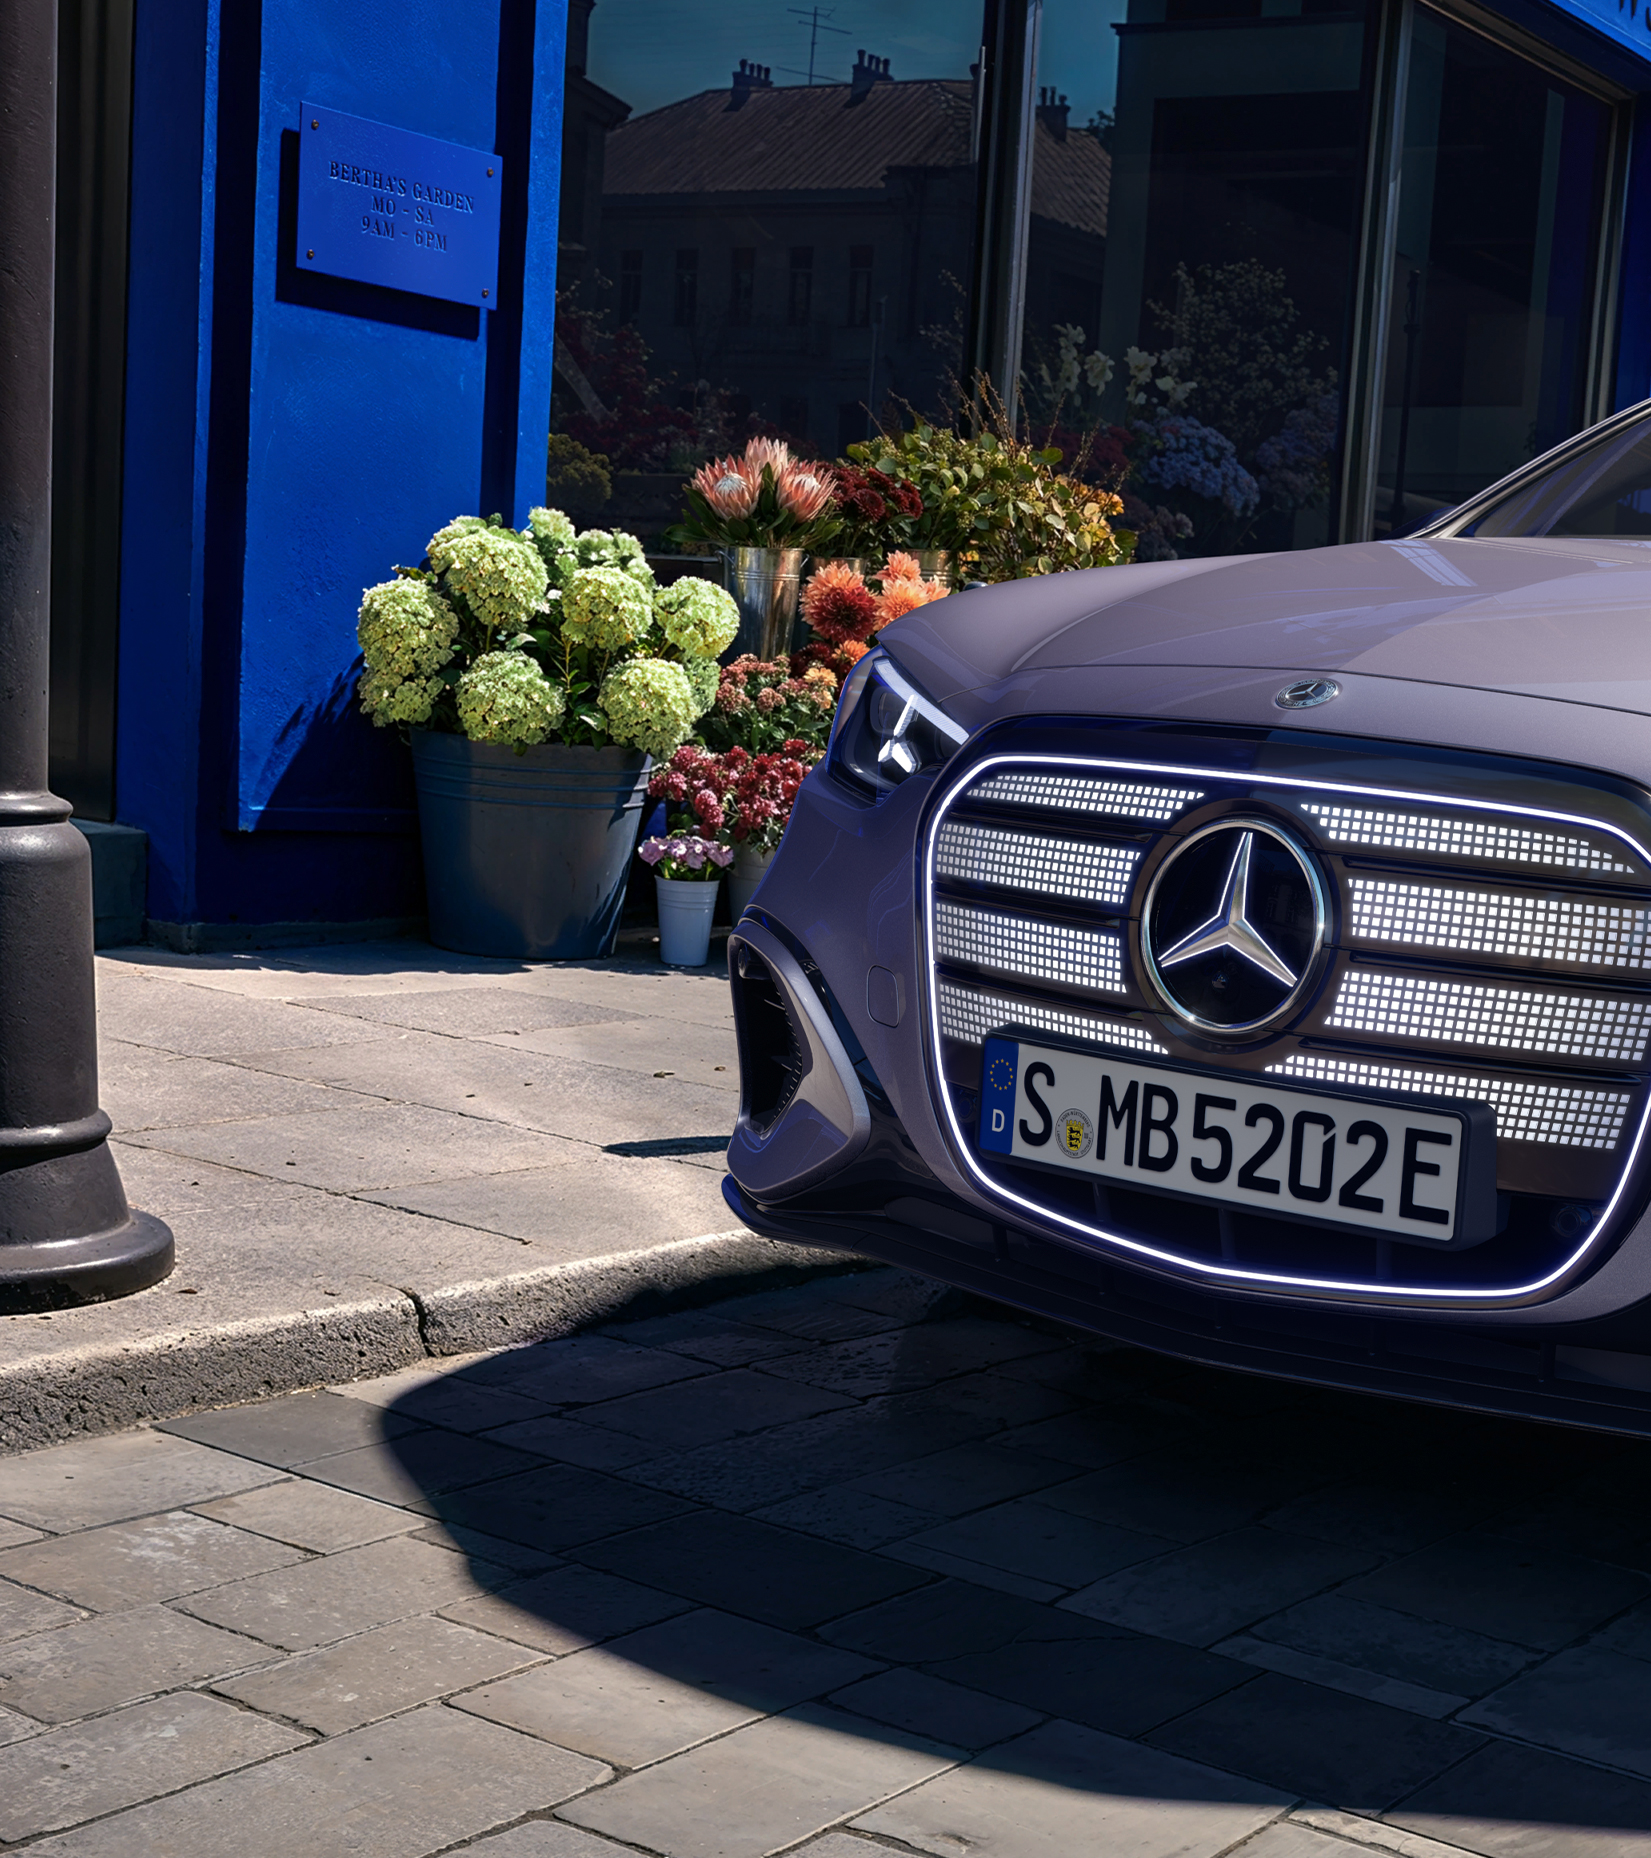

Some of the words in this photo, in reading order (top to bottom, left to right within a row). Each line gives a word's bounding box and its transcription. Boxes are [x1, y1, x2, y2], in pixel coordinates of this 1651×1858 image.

[328, 160, 407, 197] BERTHA'S
[411, 182, 474, 214] GARDEN
[370, 195, 396, 218] MO
[414, 206, 435, 228] SA
[360, 215, 395, 241] 9AM
[413, 230, 447, 253] 6PM
[991, 1109, 1005, 1132] D
[1018, 1061, 1056, 1147] S
